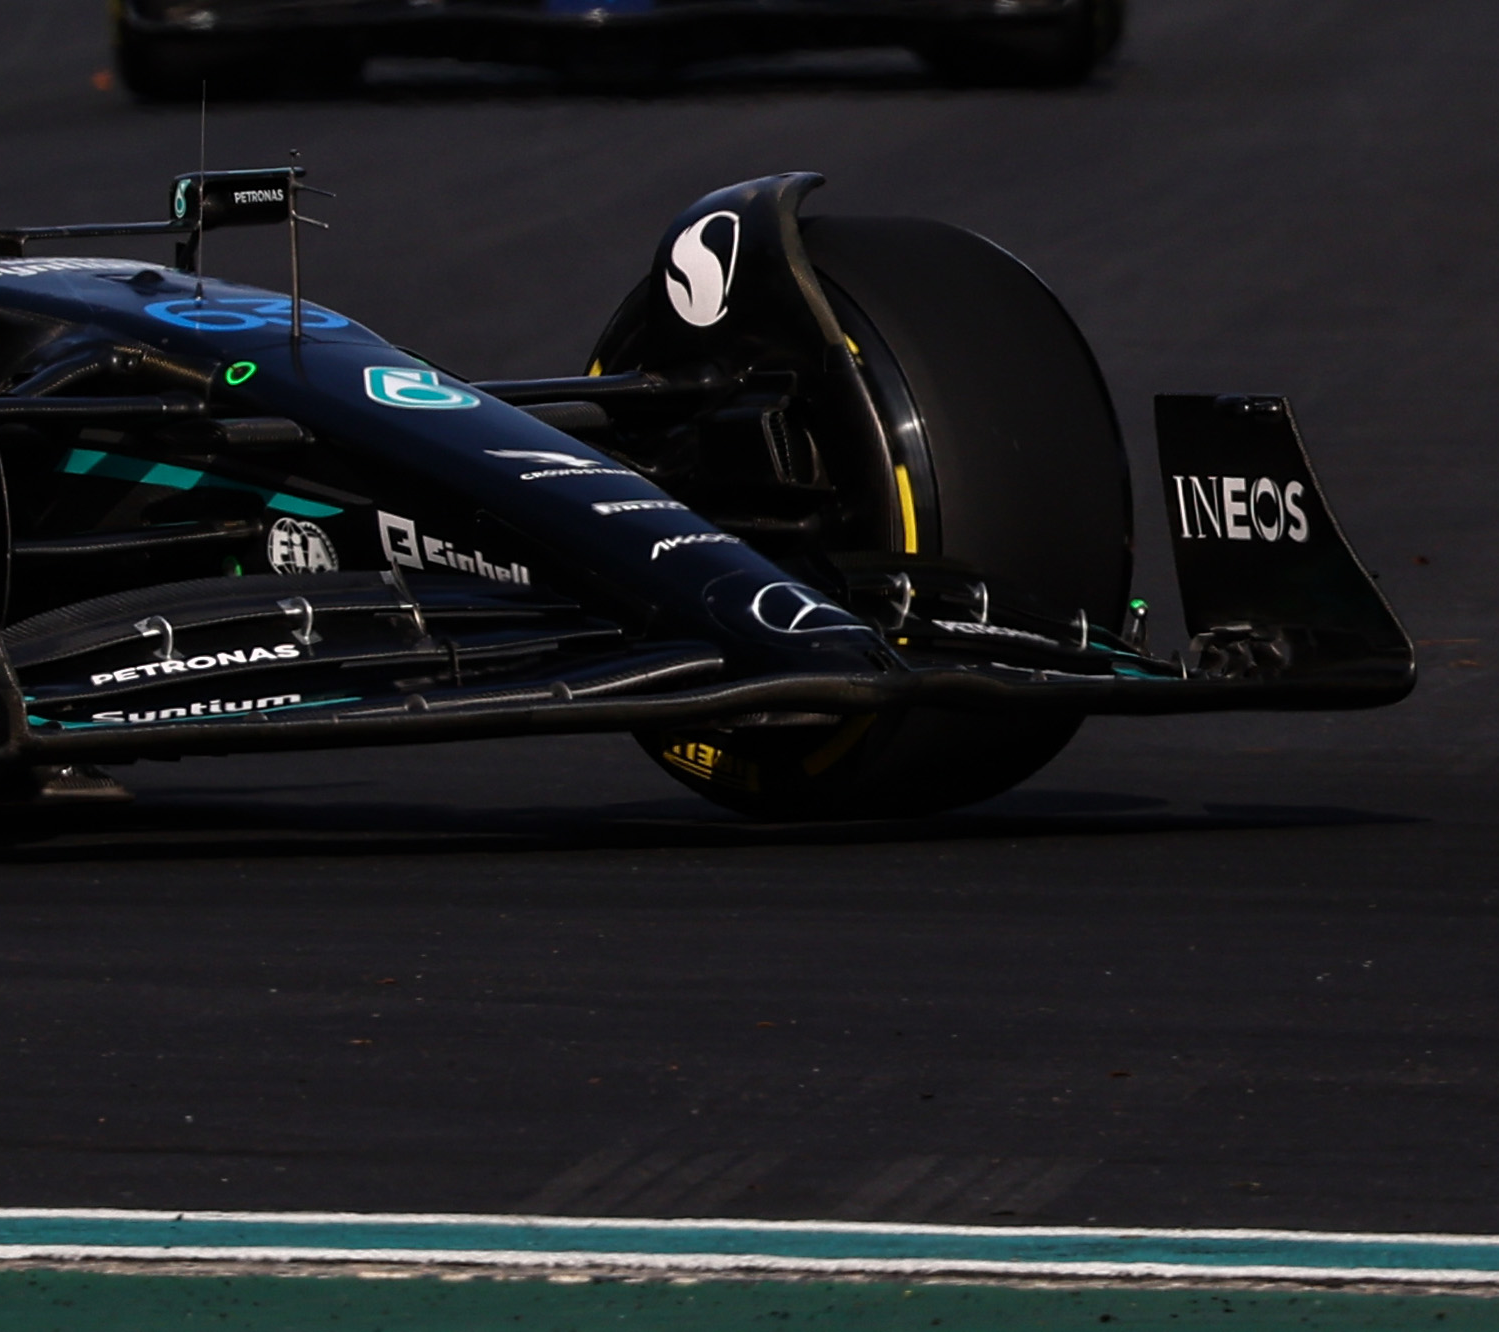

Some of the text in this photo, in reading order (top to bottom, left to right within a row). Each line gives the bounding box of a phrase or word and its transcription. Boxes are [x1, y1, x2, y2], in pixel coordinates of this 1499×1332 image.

[233, 188, 285, 204] PETRONAS
[143, 297, 351, 332] 63
[1173, 473, 1310, 544] INEOS
[422, 535, 532, 586] Einhell
[90, 643, 301, 686] PETRONAS
